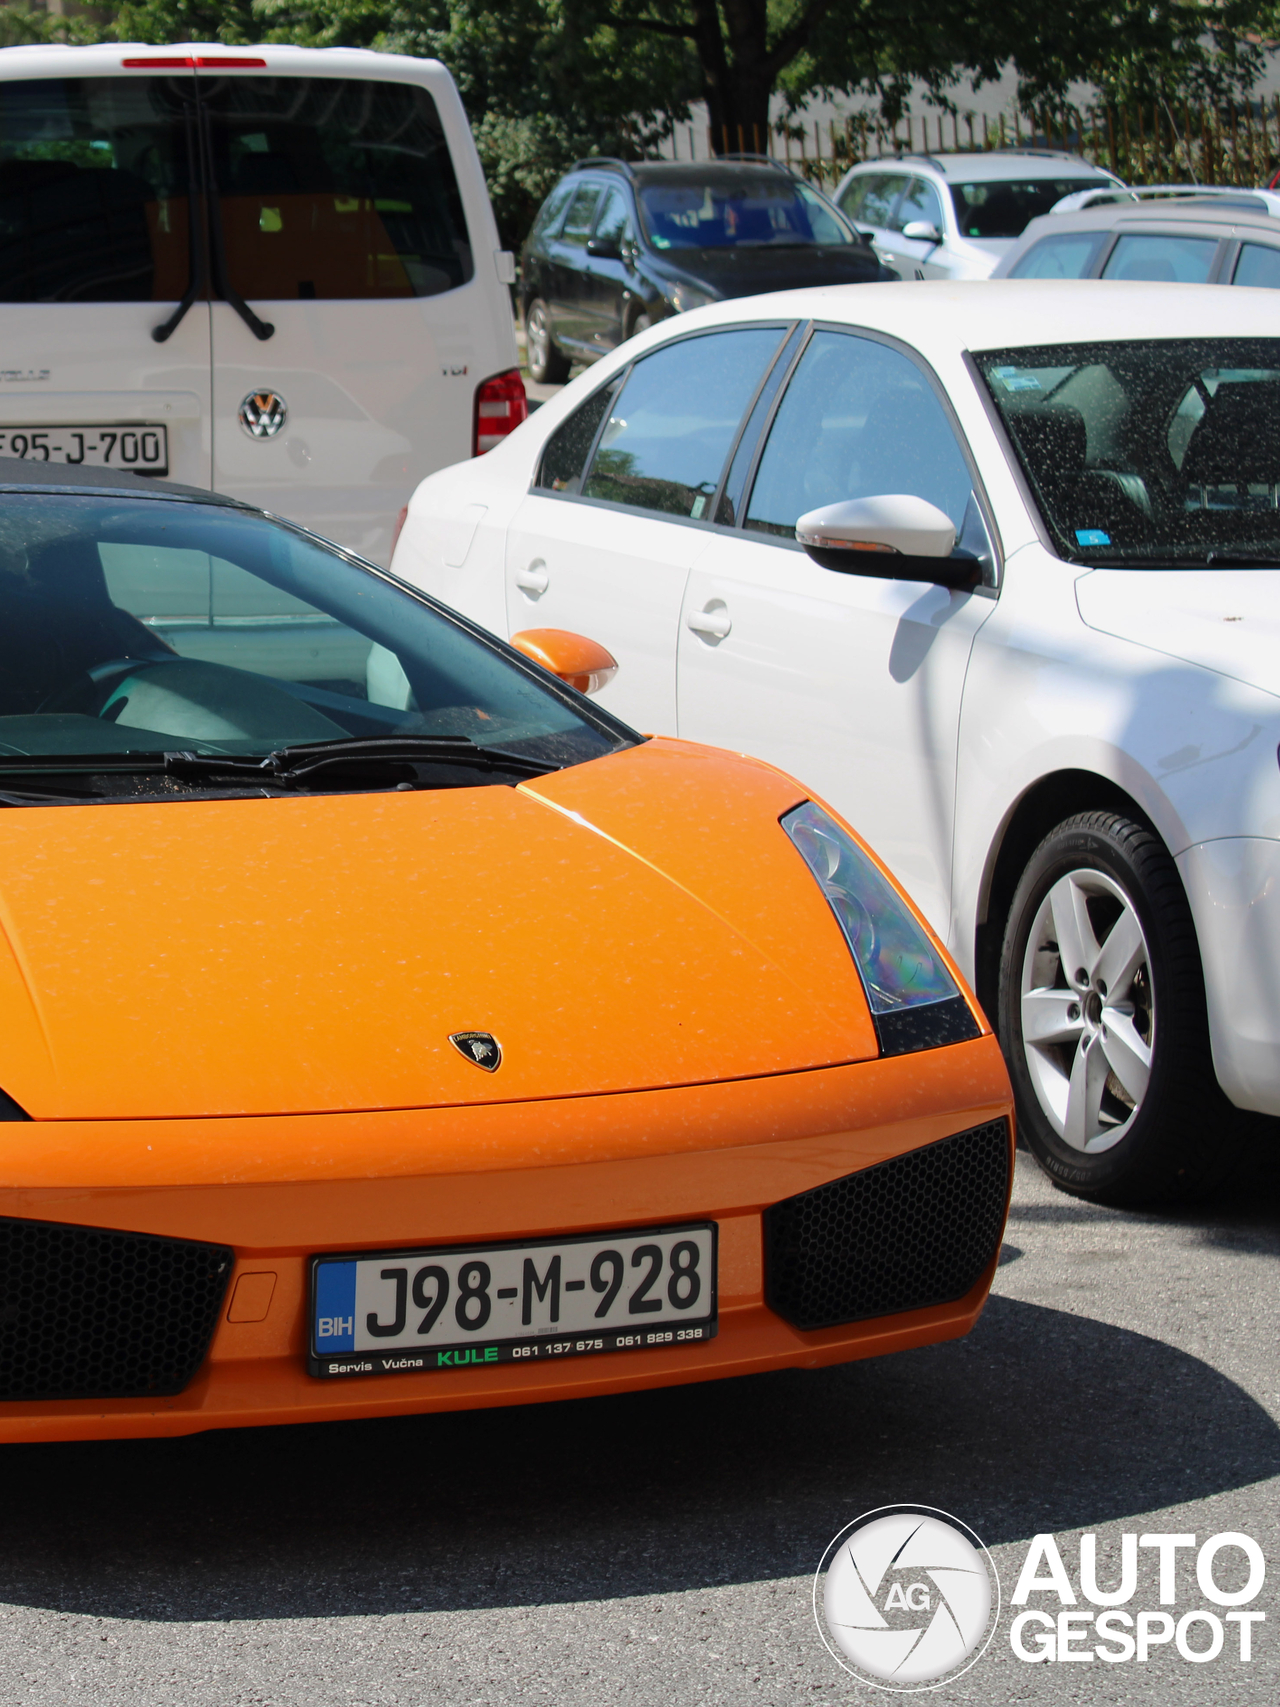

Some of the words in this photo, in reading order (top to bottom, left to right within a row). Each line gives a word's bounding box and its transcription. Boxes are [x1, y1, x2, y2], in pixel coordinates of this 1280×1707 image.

[366, 1240, 701, 1338] J98-M-928
[318, 1316, 353, 1338] BIH
[329, 1361, 373, 1373] Servis
[382, 1358, 423, 1369] Vučna
[437, 1347, 498, 1366] KULE
[512, 1347, 538, 1358] 061
[545, 1343, 571, 1354] 137
[576, 1339, 603, 1351] 675
[616, 1335, 641, 1347] 061
[646, 1332, 673, 1344] 829
[677, 1328, 703, 1340] 338
